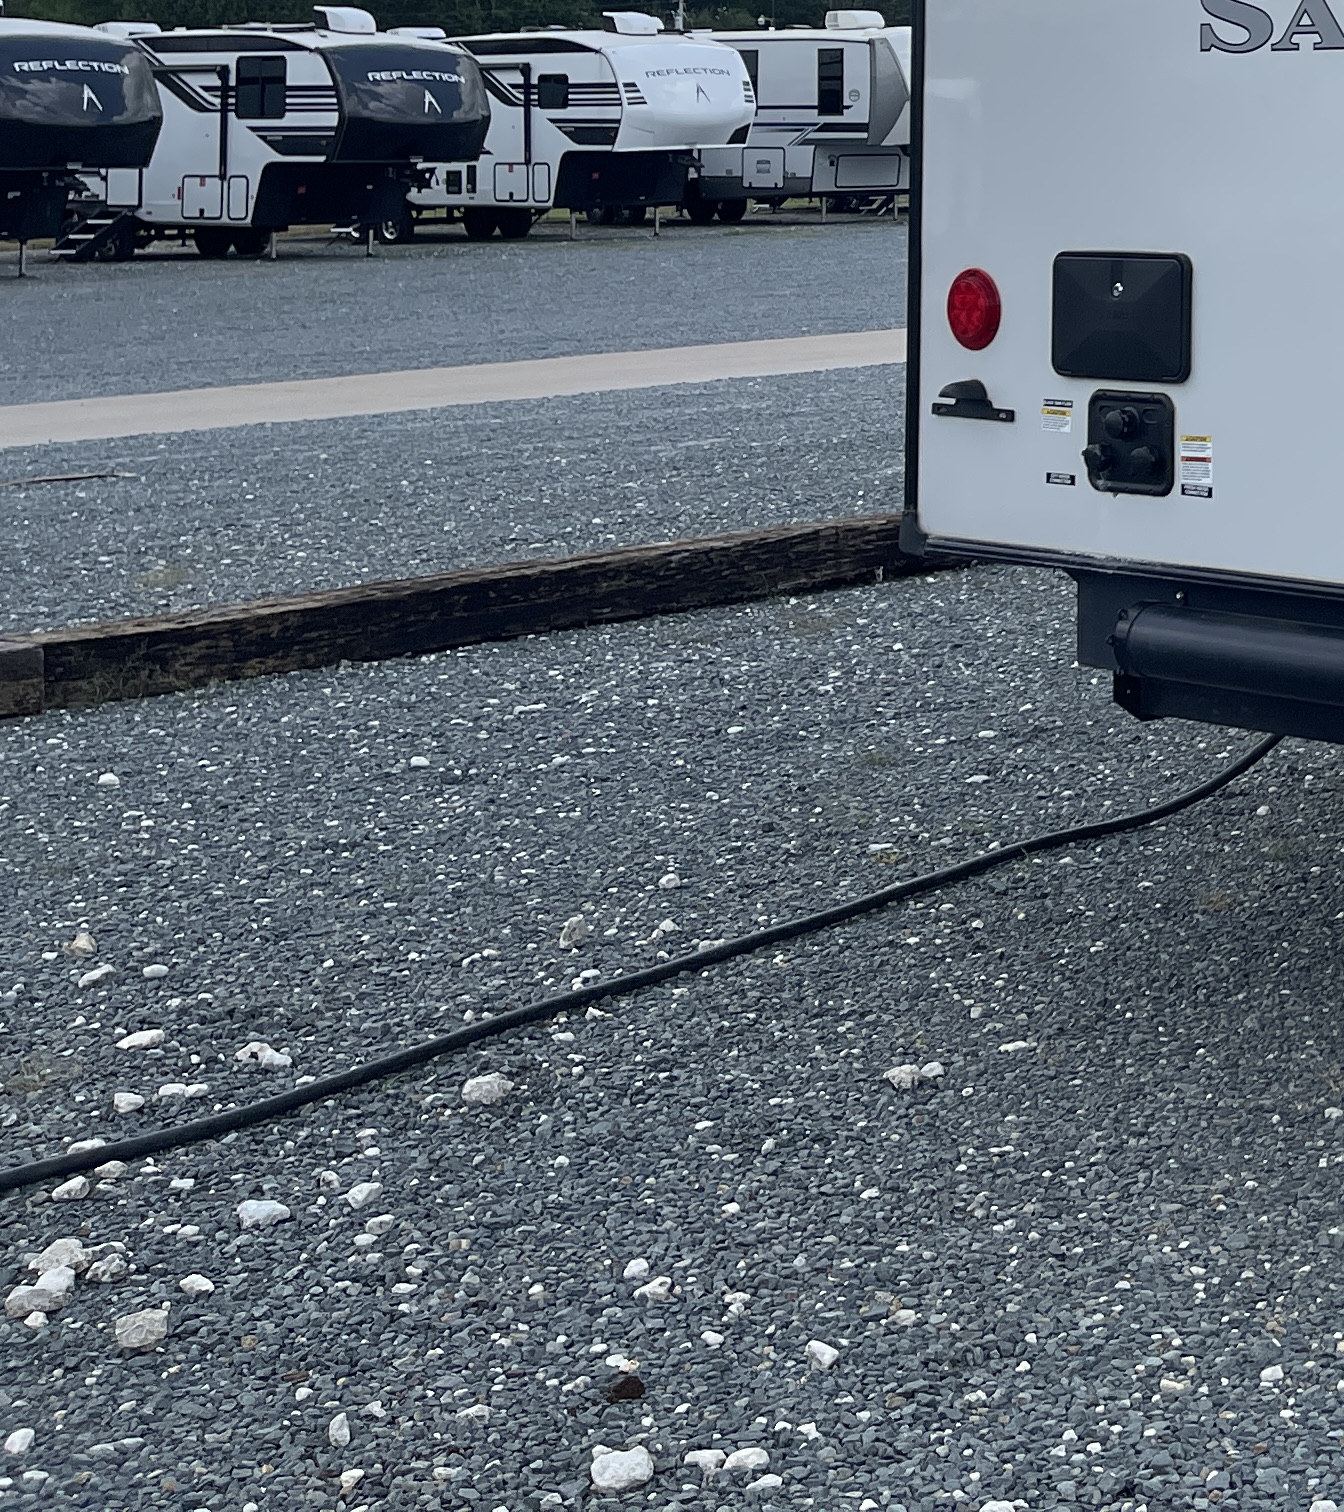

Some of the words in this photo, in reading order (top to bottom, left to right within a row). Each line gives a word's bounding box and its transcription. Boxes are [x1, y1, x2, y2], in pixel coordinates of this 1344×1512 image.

[13, 59, 130, 75] REFLECTION
[644, 67, 731, 78] REFLECTION
[367, 70, 466, 84] REFLECTION
